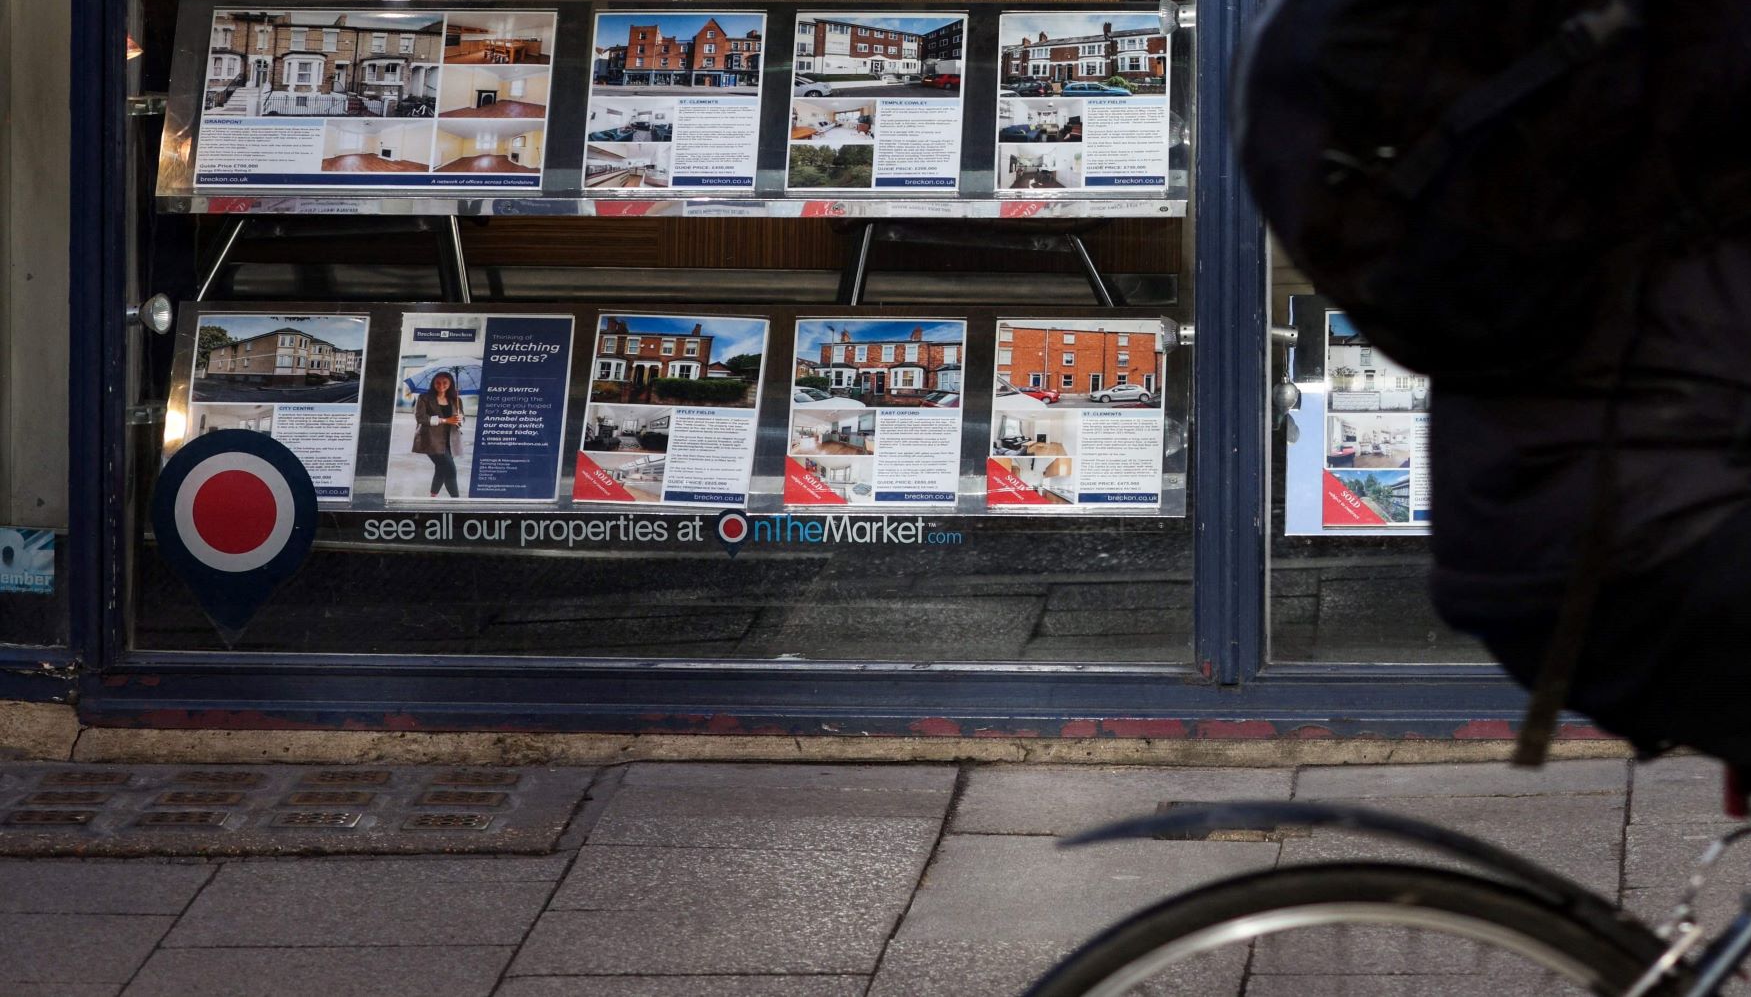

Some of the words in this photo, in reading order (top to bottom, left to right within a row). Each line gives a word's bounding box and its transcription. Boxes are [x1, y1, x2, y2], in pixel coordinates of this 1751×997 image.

[491, 342, 560, 353] switching
[490, 354, 547, 363] agents?
[593, 469, 613, 486] SOLD
[803, 474, 823, 492] SOLD
[1340, 490, 1361, 509] SOLD
[363, 518, 415, 540] see
[425, 514, 453, 540] all
[463, 519, 511, 540] our
[520, 514, 668, 547] properties
[677, 516, 703, 542] at
